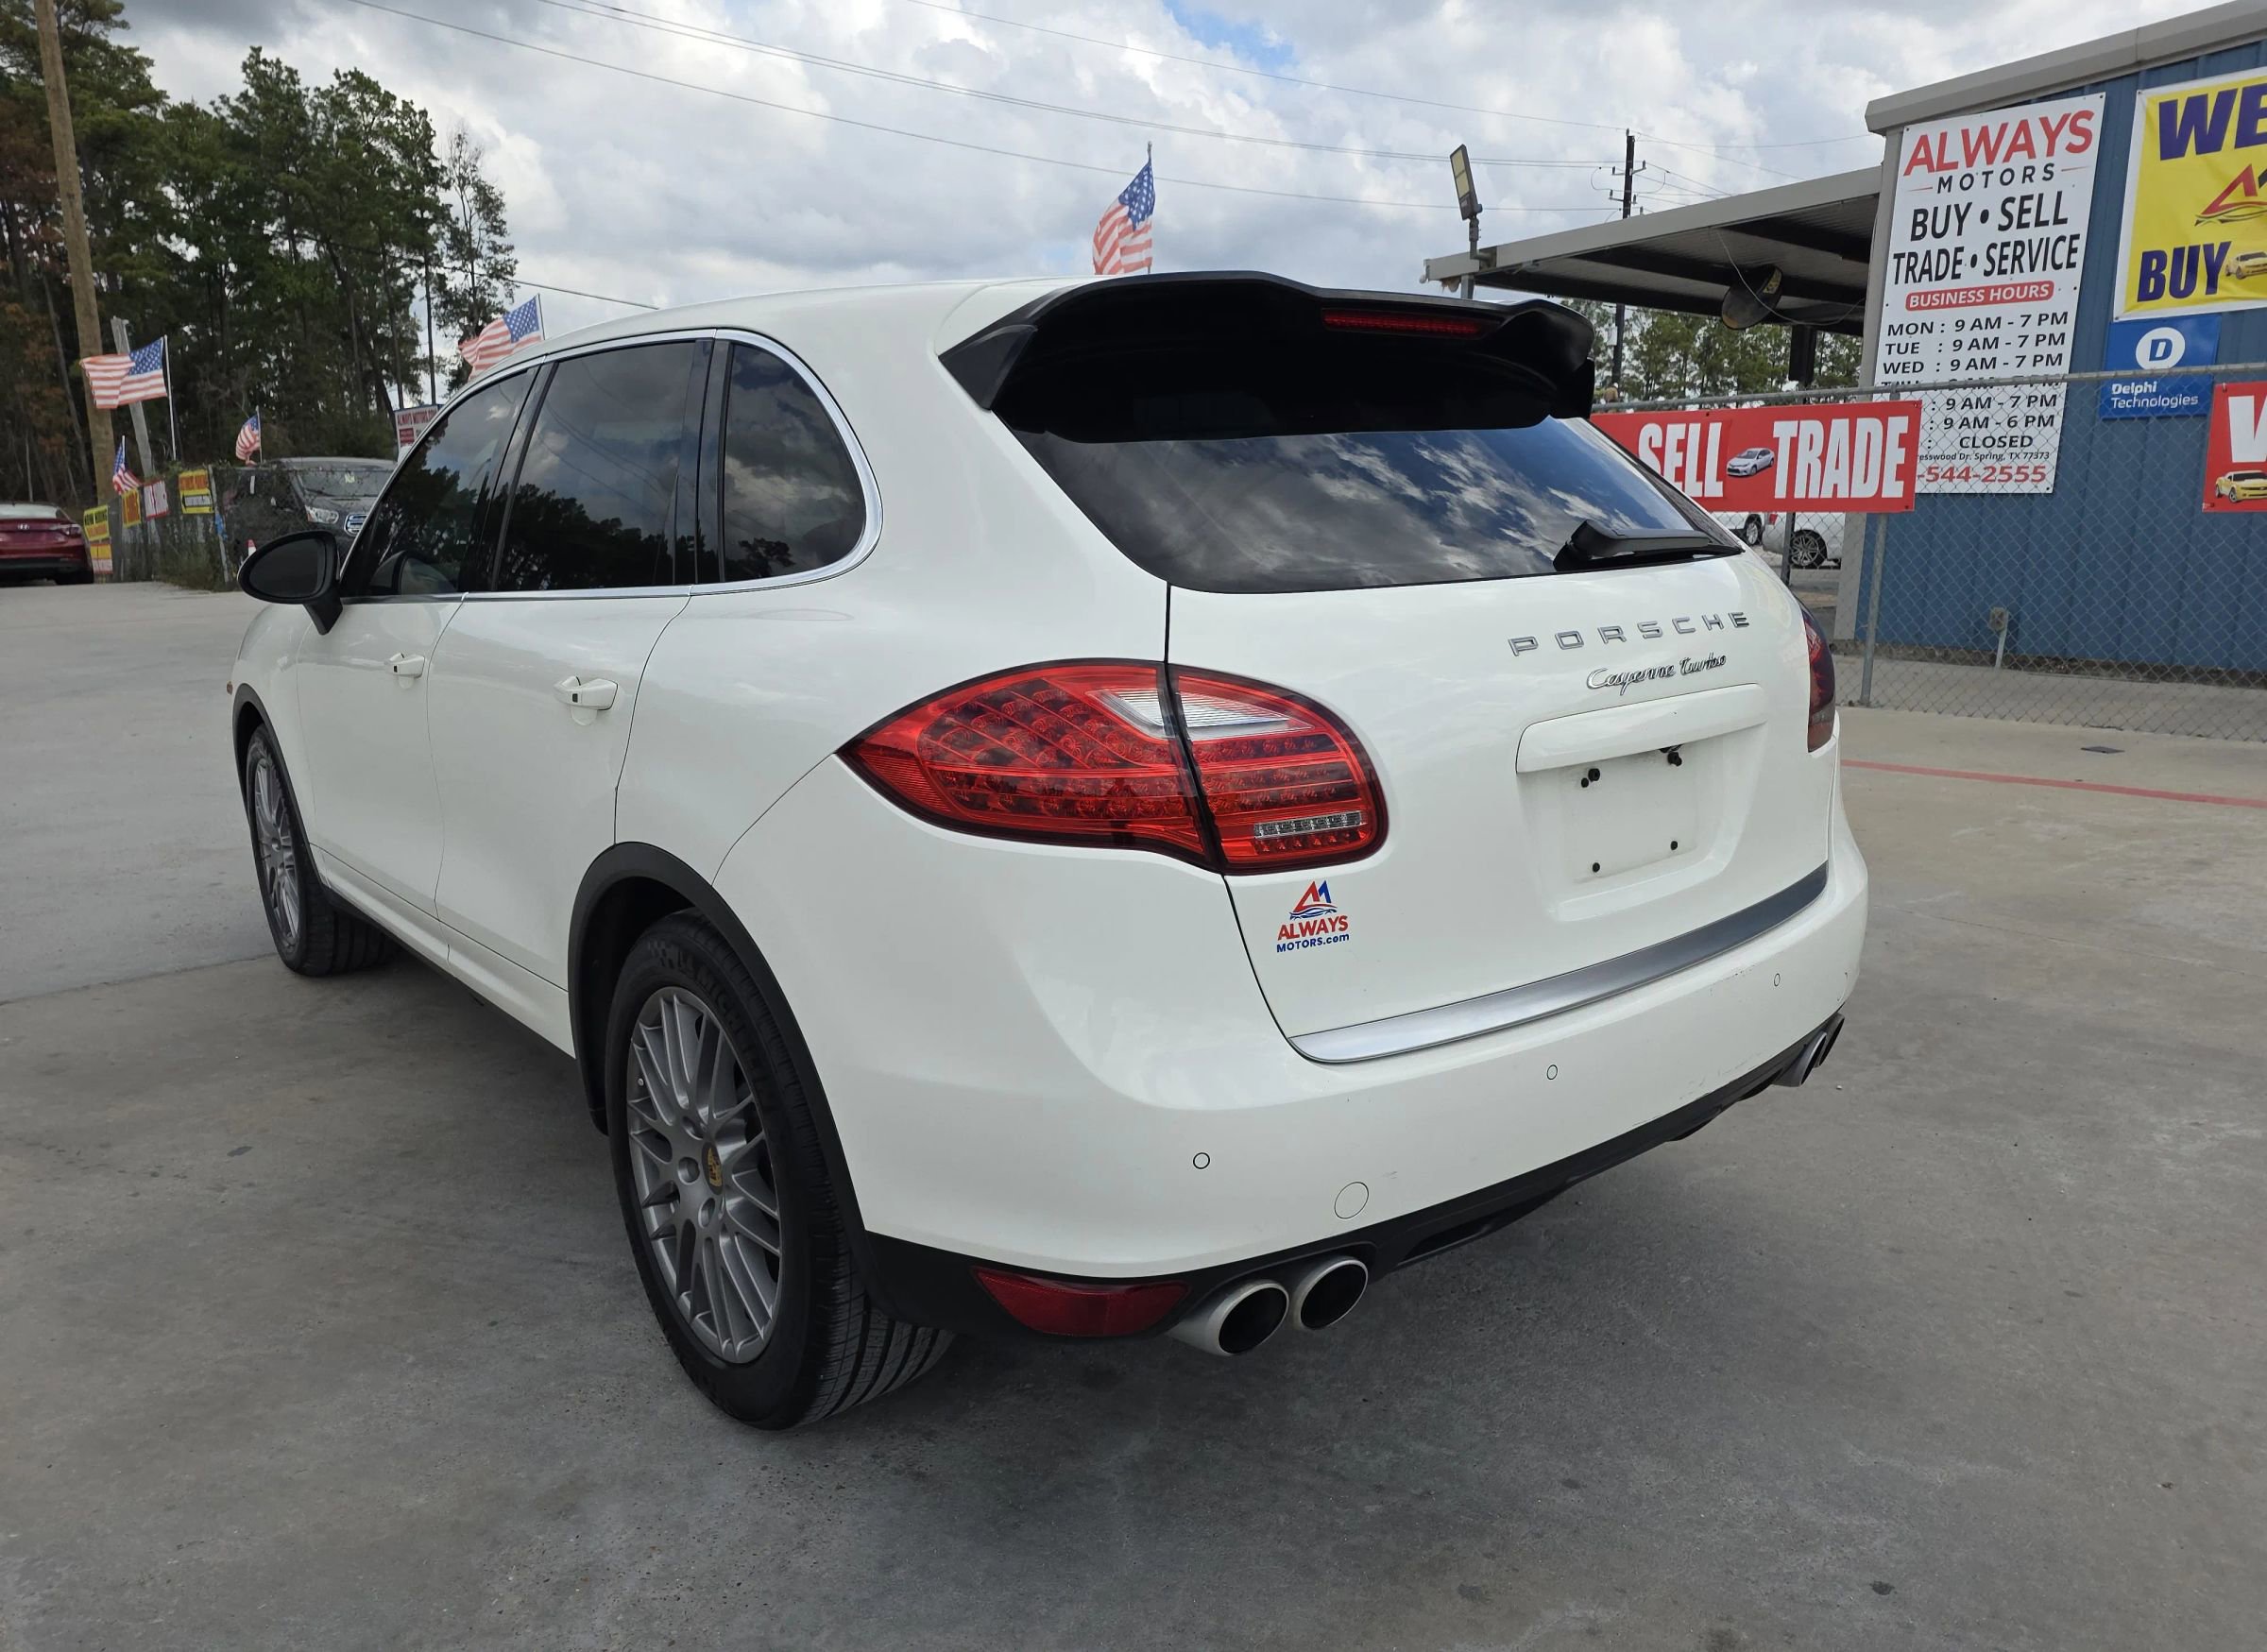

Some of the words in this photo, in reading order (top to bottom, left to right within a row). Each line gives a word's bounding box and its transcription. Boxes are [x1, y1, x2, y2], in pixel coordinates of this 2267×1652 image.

[2158, 82, 2267, 161] WE
[1903, 110, 2094, 177] ALWAYS
[1937, 162, 2055, 194] MOTORS
[1910, 201, 1972, 242] BUY
[1998, 191, 2069, 231] SELL
[1893, 246, 1965, 285] TRADE
[1984, 233, 2081, 277] SERVICE
[2137, 241, 2232, 302] BUY
[1909, 289, 1985, 308] BUSINESS
[1989, 283, 2051, 301] HOURS
[1887, 321, 1935, 337] MON
[1954, 318, 1966, 332] 9
[1969, 315, 2002, 332] AM
[2020, 314, 2032, 328] 7
[2037, 311, 2069, 327] PM
[1884, 341, 1920, 356] TUE
[1952, 339, 1963, 352] 9
[1967, 336, 2000, 351] AM
[2017, 334, 2030, 349] 7
[2035, 332, 2066, 348] PM
[1883, 361, 1925, 375] WED
[1950, 358, 1961, 372] 9
[1965, 356, 1997, 371] AM
[2015, 354, 2027, 368] 7
[2032, 352, 2063, 367] PM
[2111, 381, 2157, 396] Delphi
[2111, 394, 2199, 409] Technologies
[1945, 397, 1956, 410] 9
[1960, 396, 1992, 410] AM
[2009, 395, 2021, 409] 7
[2026, 394, 2057, 407] PM
[1942, 417, 1954, 430] 9
[1958, 416, 1989, 430] AM
[2006, 415, 2019, 429] 6
[2024, 414, 2055, 428] PM
[1959, 434, 2034, 449] CLOSED
[1638, 421, 1723, 498] SELL
[1773, 416, 1909, 499] TRADE
[1959, 451, 1972, 461] Dr.
[1974, 451, 2005, 462] Spring,
[2022, 451, 2050, 460] 77373
[1508, 611, 1749, 656] PORSCHE
[1586, 667, 1677, 696] Cayenne
[1277, 914, 1349, 941] ALWAYS
[1276, 933, 1350, 953] MOTORS.com
